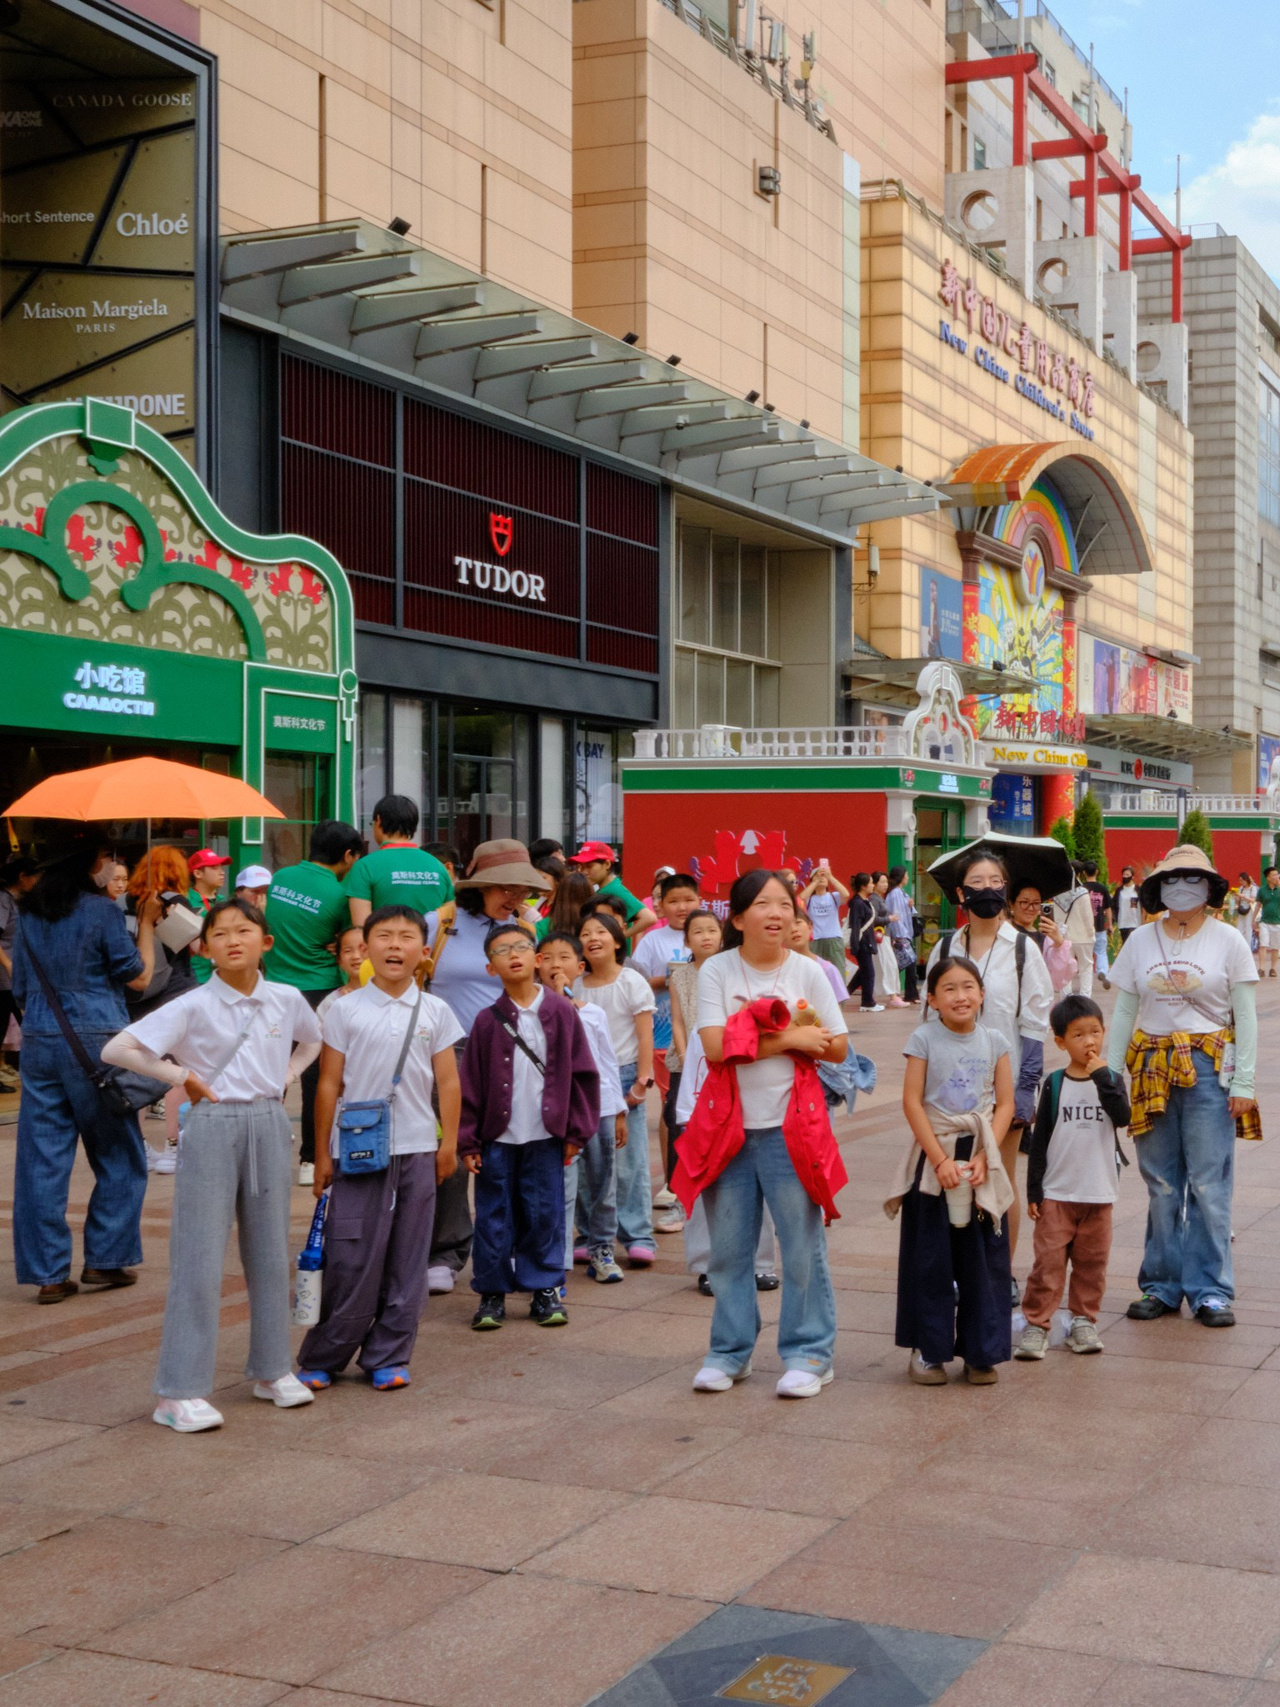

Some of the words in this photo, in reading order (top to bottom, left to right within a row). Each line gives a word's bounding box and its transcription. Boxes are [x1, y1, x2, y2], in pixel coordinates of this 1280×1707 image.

[52, 94, 126, 108] CANADA
[132, 92, 192, 107] GOOSE
[34, 210, 95, 224] Sentence
[116, 212, 189, 237] Chloé
[23, 302, 87, 320] Maison
[92, 297, 168, 320] Margiela
[76, 323, 116, 334] PARIS
[940, 320, 968, 355] New
[975, 345, 1010, 384] China
[1070, 410, 1095, 441] Store
[454, 556, 546, 602] TUDOR
[75, 661, 146, 695] 小吃馆
[273, 715, 326, 731] 莫斯科文化节
[992, 746, 1028, 761] New
[1033, 748, 1069, 765] China
[1062, 1105, 1104, 1123] NICE
